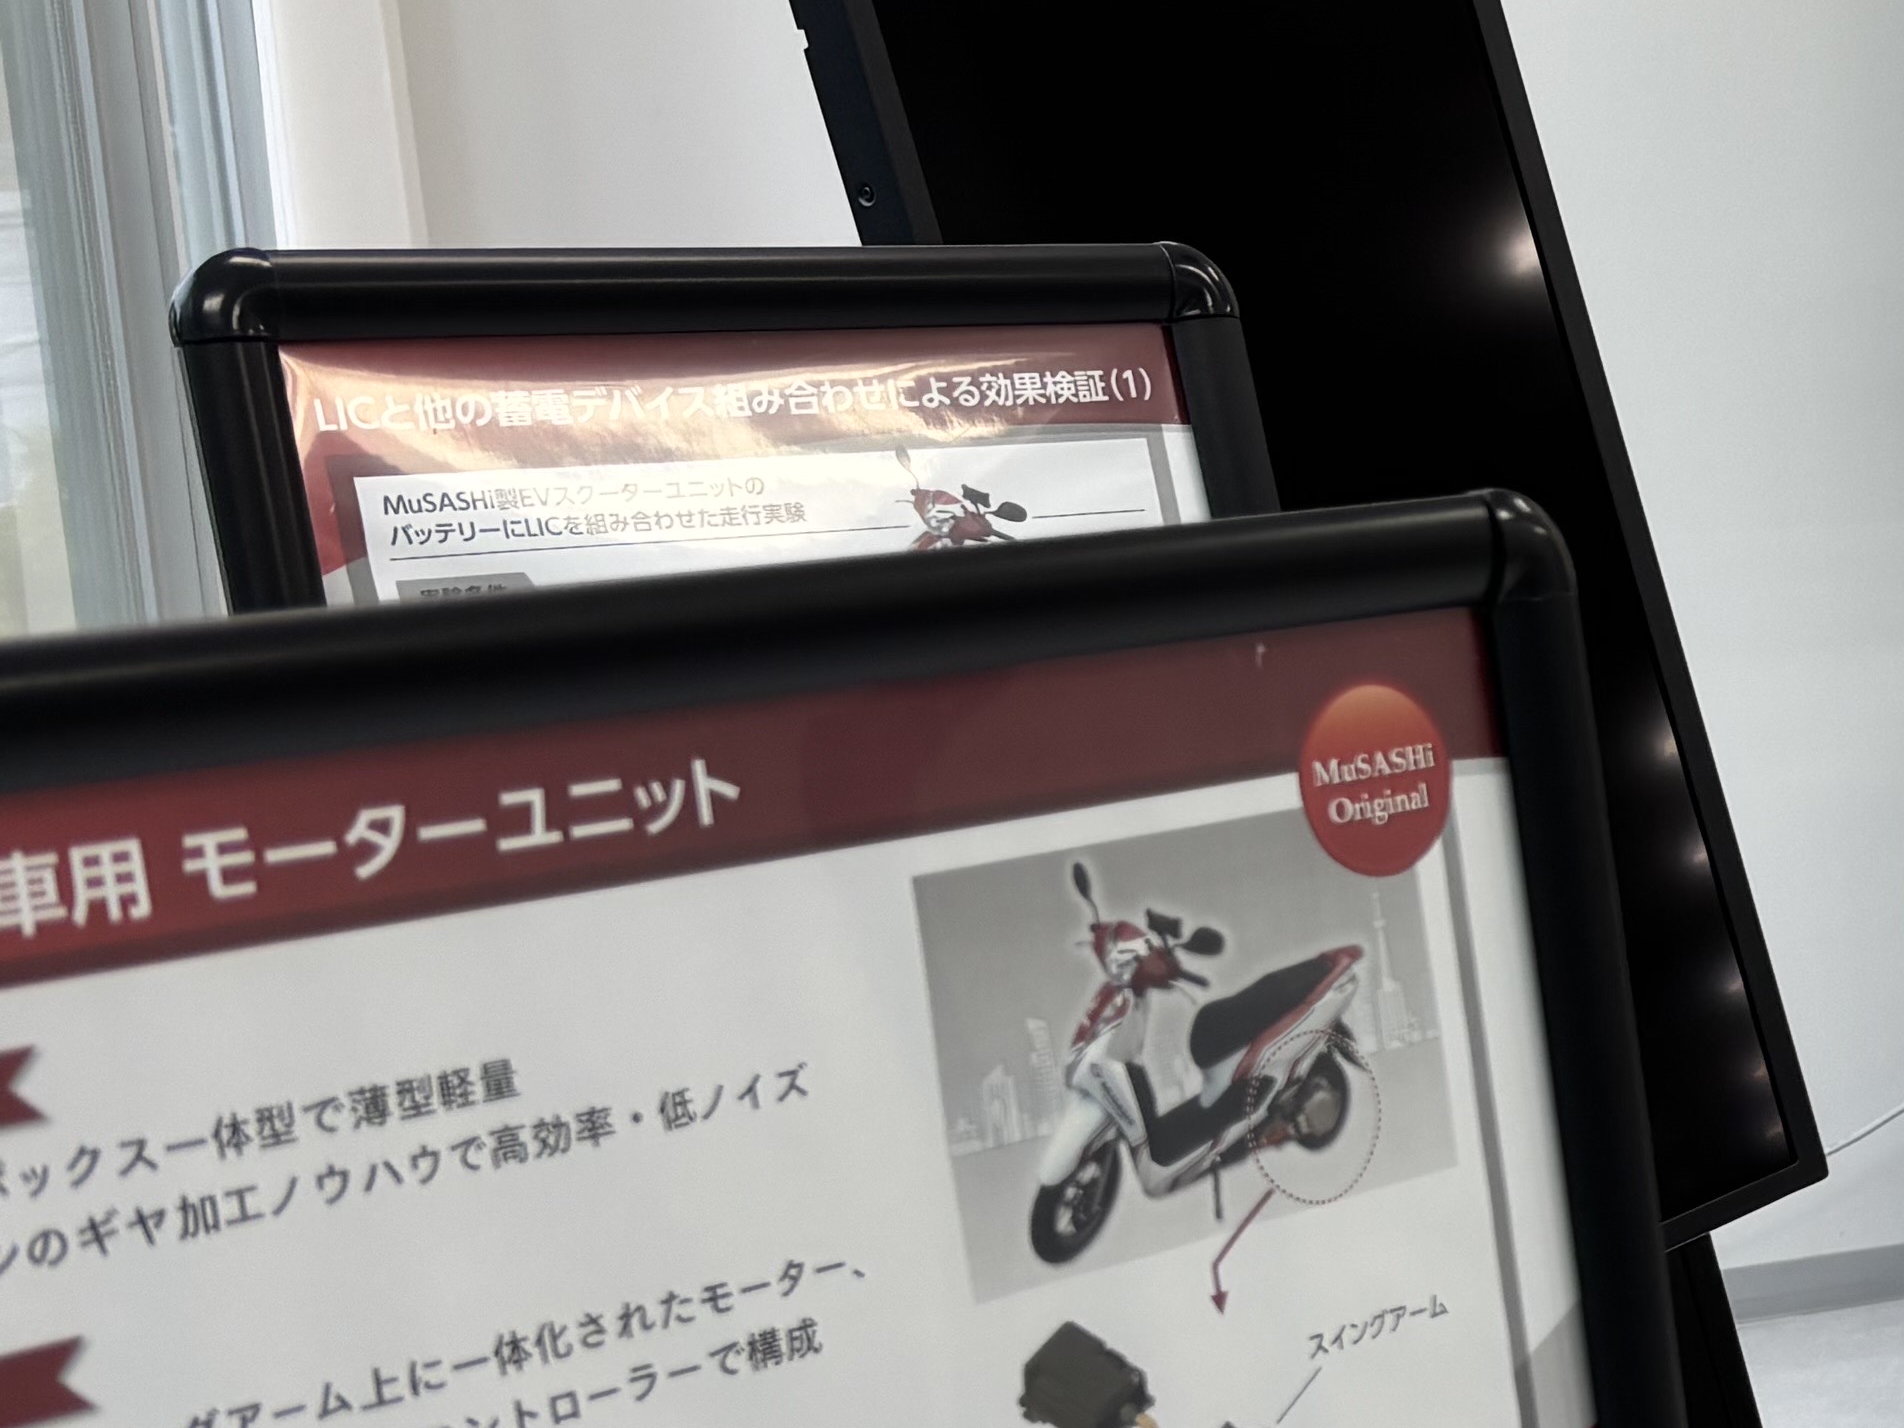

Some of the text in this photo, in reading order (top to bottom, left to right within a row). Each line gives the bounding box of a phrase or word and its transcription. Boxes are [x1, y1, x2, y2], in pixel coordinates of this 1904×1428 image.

[389, 502, 807, 547] バッテリーにLICを組み合わせた走行実験
[1311, 742, 1436, 787] MuSASHi
[181, 757, 742, 900] モーターユニット
[1328, 782, 1431, 826] Original
[0, 1058, 521, 1200] ックス一体型で薄型軽量
[1308, 1294, 1450, 1361] スイングアーム
